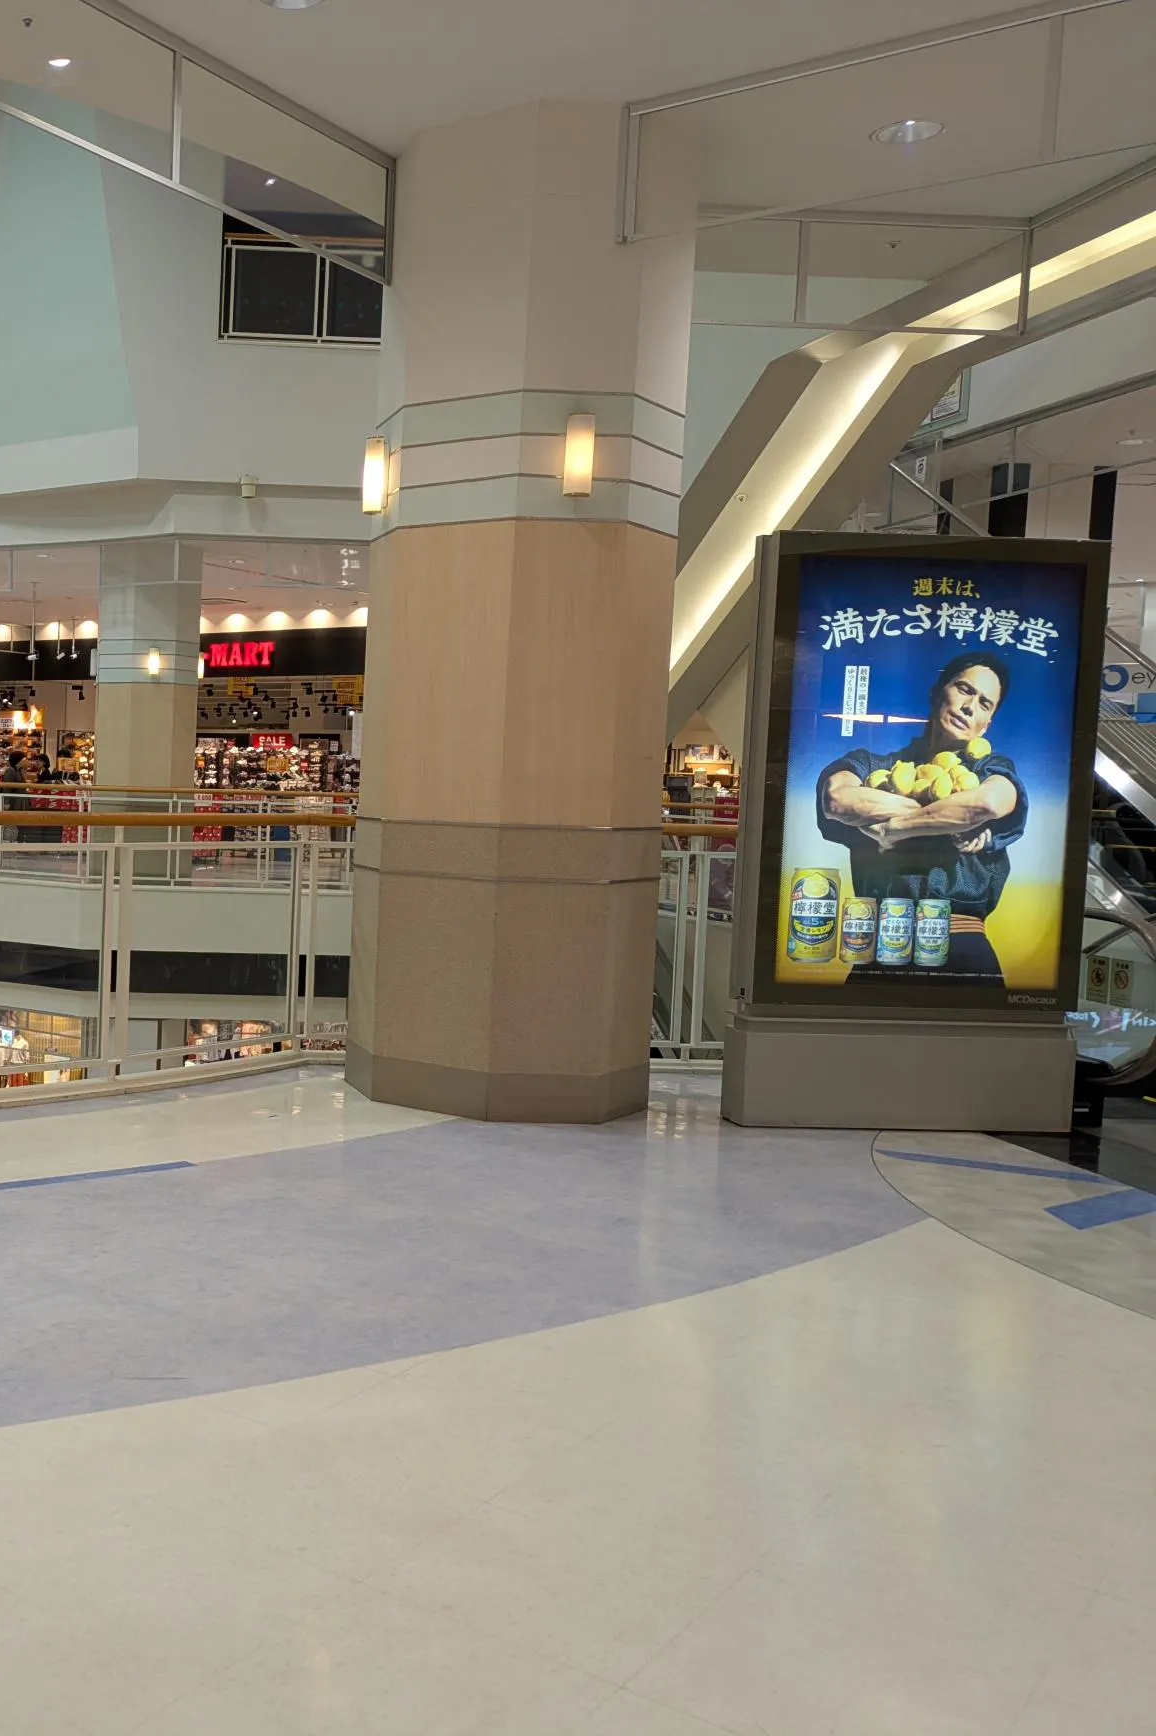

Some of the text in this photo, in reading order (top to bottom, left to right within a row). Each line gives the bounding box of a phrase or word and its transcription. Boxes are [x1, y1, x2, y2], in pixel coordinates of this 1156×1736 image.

[912, 576, 981, 599] 週末は、
[819, 602, 1059, 657] 満たさ檸檬堂
[258, 735, 286, 747] SALE
[793, 901, 835, 915] 檸檬堂
